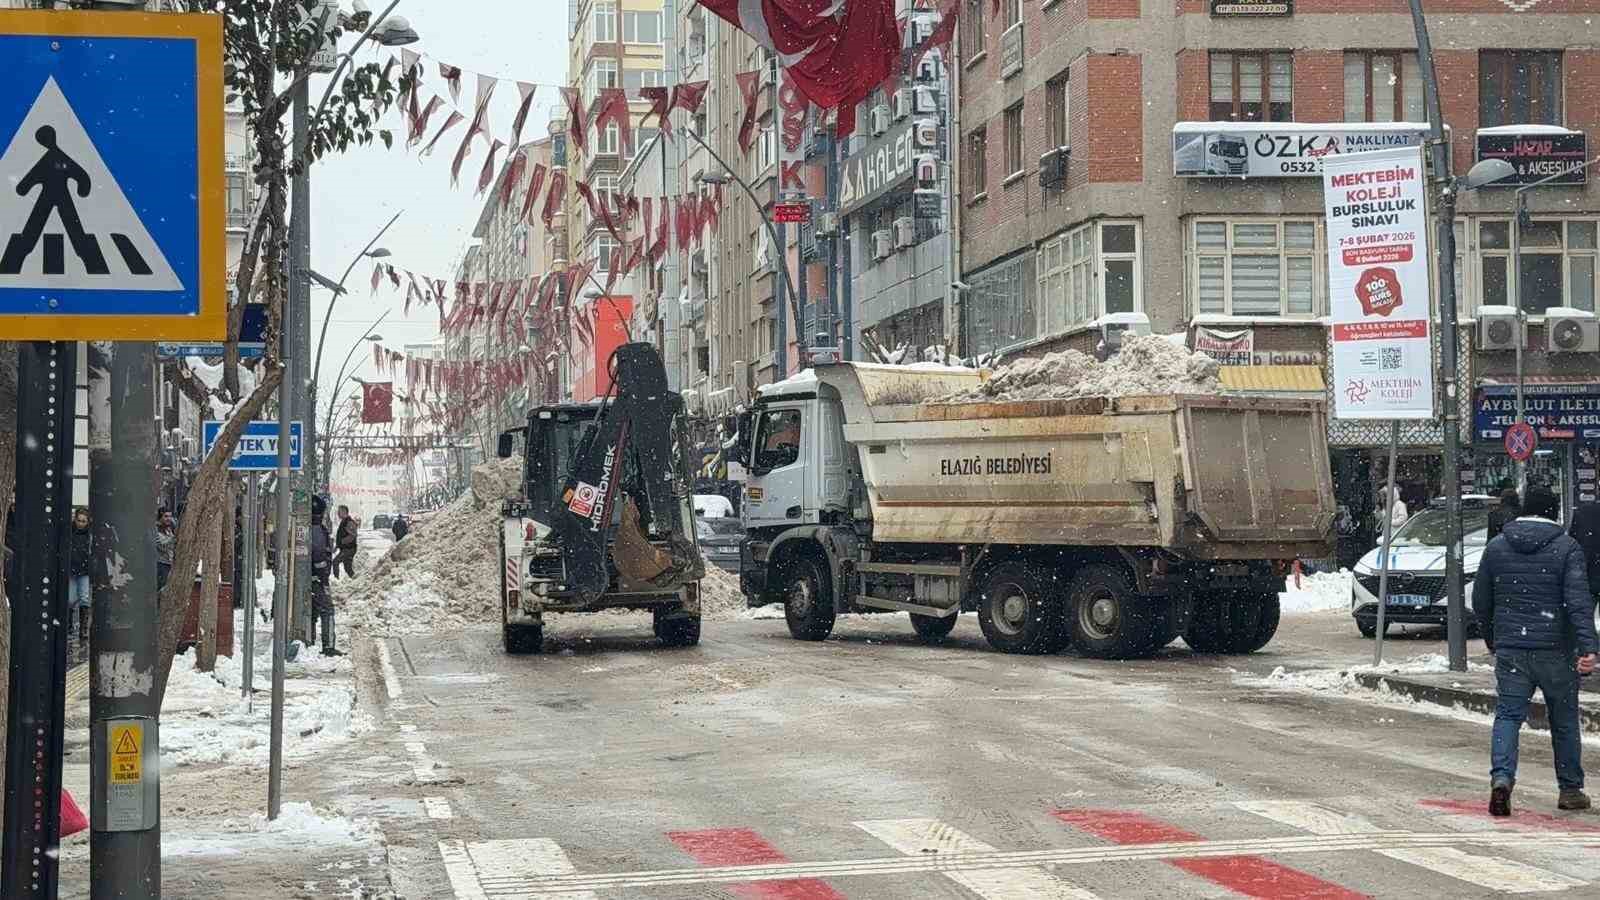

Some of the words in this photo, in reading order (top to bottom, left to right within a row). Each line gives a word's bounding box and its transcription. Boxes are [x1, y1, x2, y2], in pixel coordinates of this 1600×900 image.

[1280, 161, 1316, 173] 0532
[1331, 165, 1415, 187] MEKTEBİM
[1346, 182, 1401, 203] KOLEJİ
[1332, 199, 1416, 218] BURSLULUK
[1351, 214, 1399, 228] SINAVI
[1356, 234, 1389, 244] ŞUBAT
[1491, 415, 1545, 425] TELON
[240, 438, 263, 451] TEK
[267, 438, 297, 451] YN
[941, 456, 981, 475] ELAZIĞ
[986, 452, 1052, 475] BELEDİYESİ
